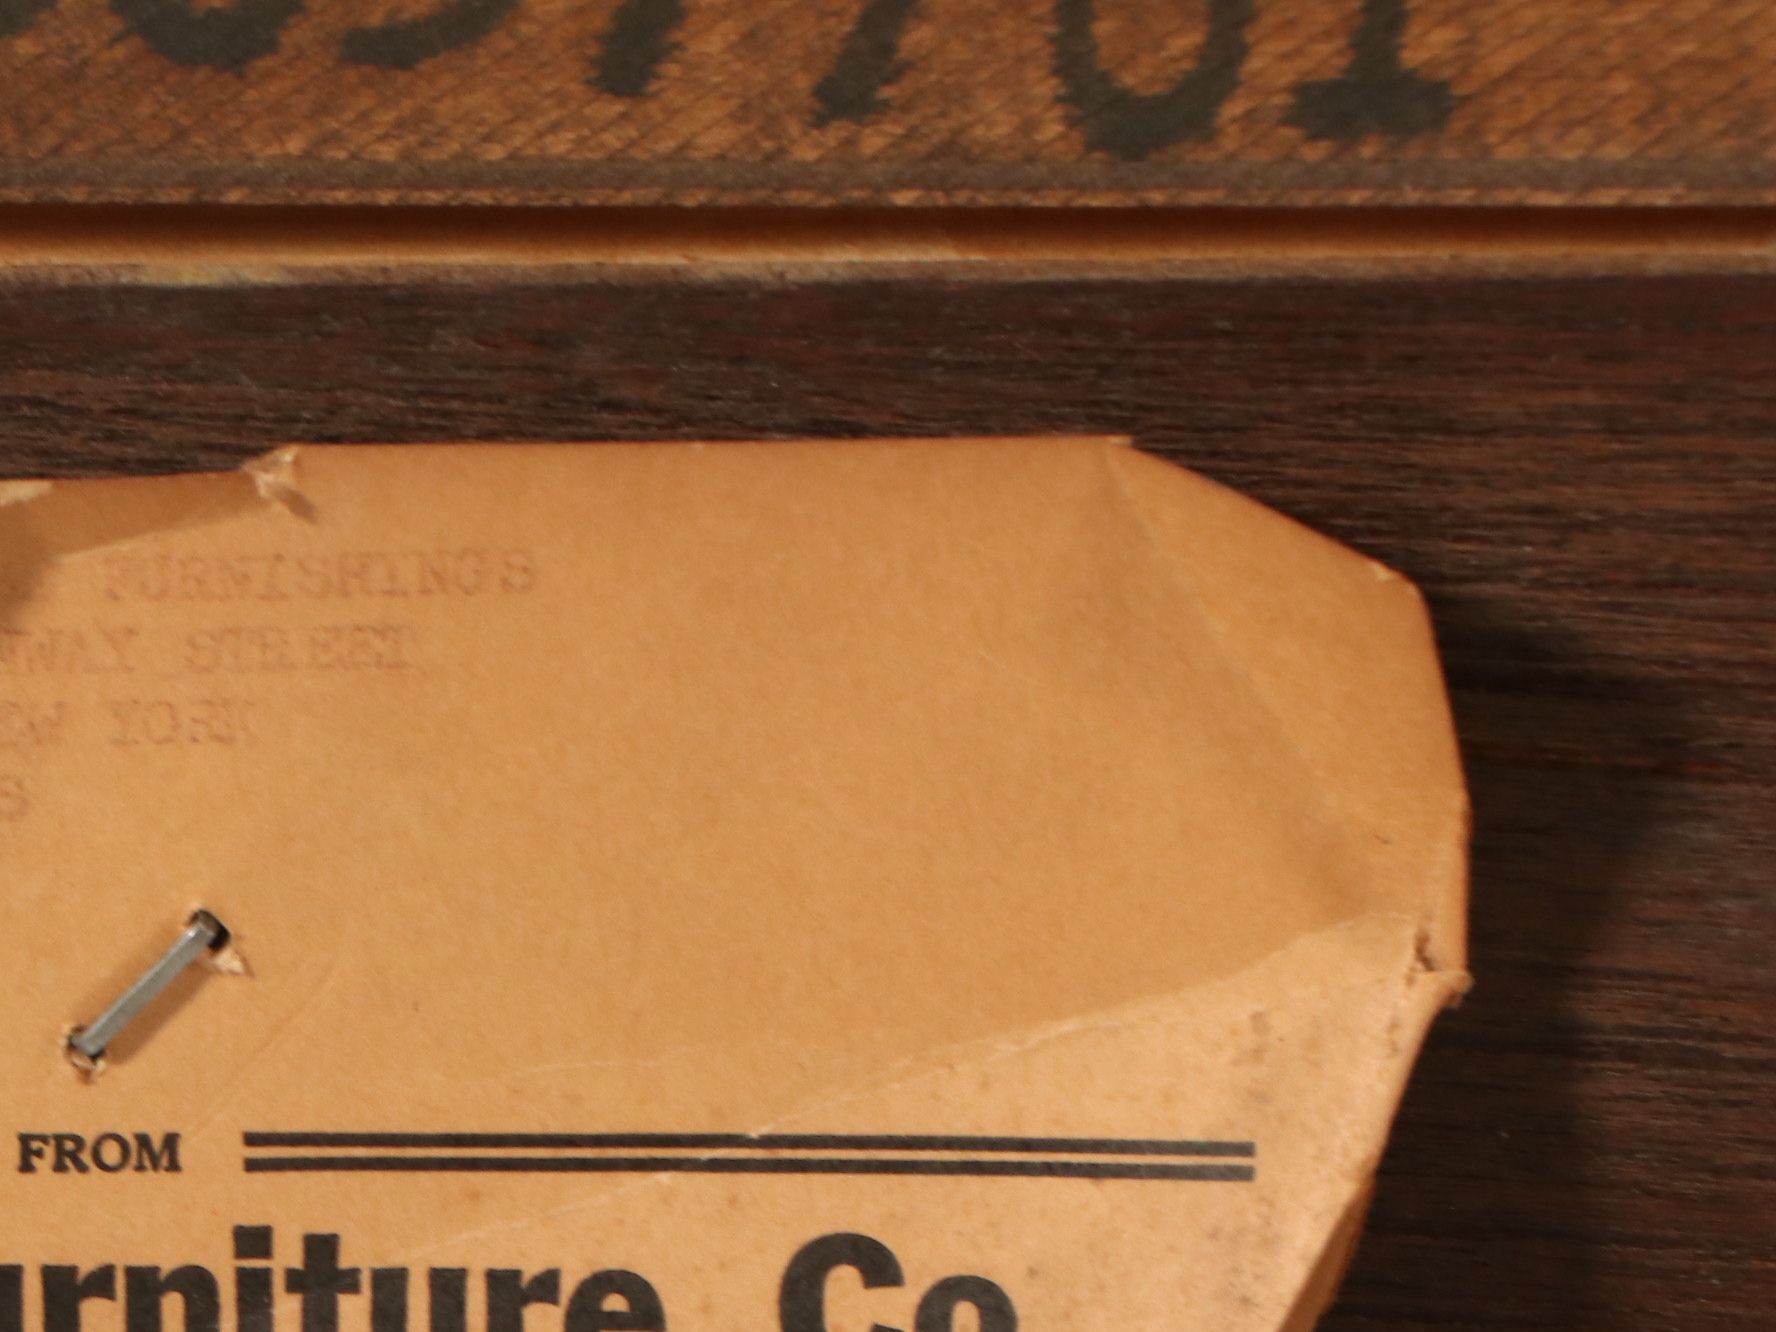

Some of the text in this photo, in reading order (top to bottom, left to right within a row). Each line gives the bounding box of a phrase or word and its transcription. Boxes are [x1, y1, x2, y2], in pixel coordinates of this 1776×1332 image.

[102, 548, 540, 604] FURNISHINGS
[185, 624, 418, 673] STREET
[107, 697, 260, 747] YORK
[17, 1132, 182, 1175] FROM
